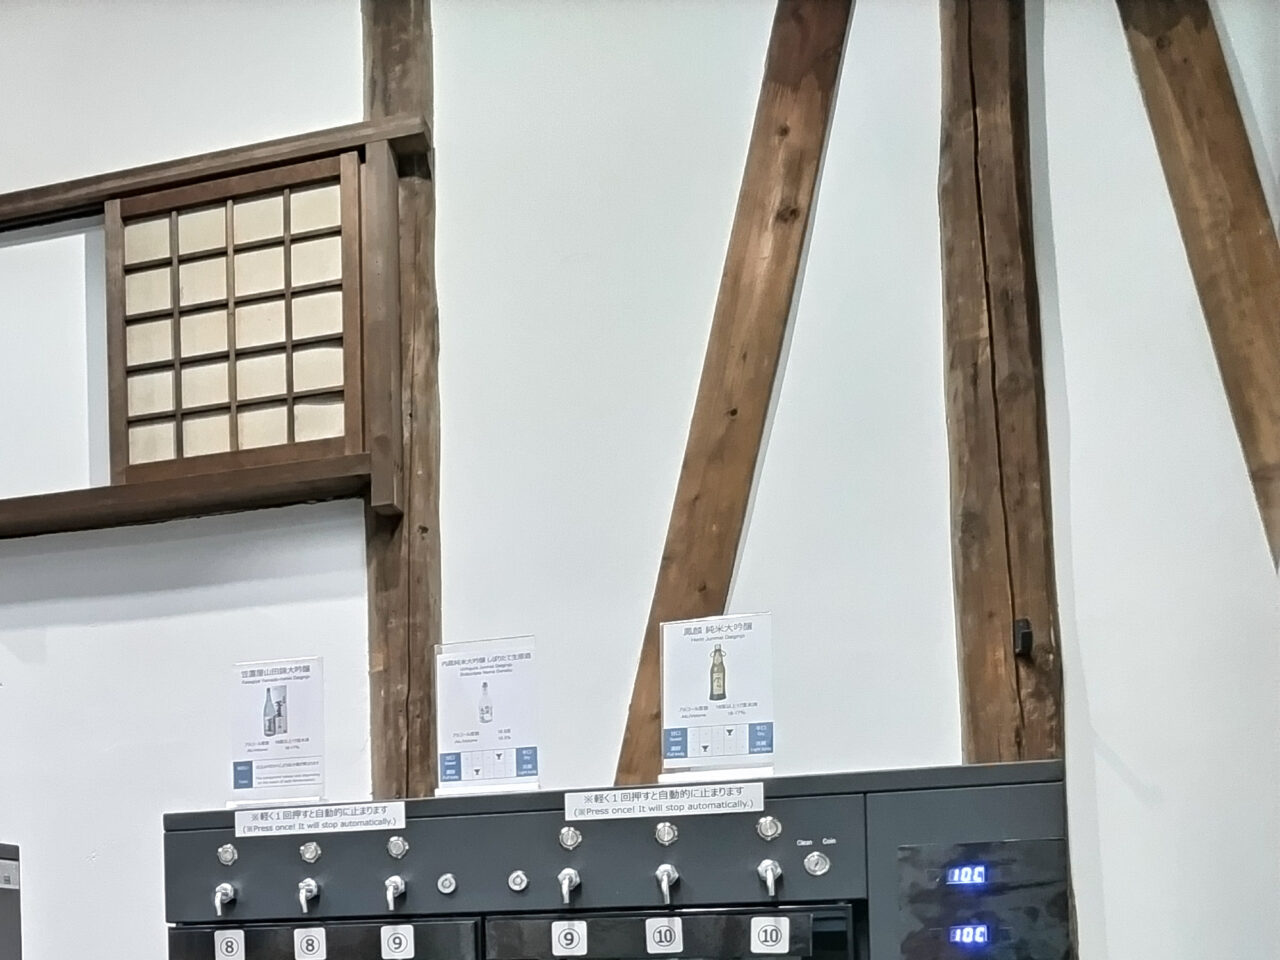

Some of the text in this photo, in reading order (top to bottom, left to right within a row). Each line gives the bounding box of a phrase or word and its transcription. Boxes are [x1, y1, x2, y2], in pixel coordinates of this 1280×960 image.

[611, 806, 635, 814] once!
[648, 804, 662, 812] will
[665, 804, 682, 813] stop
[275, 823, 295, 831] once!
[307, 821, 320, 829] will
[321, 821, 337, 830] stop
